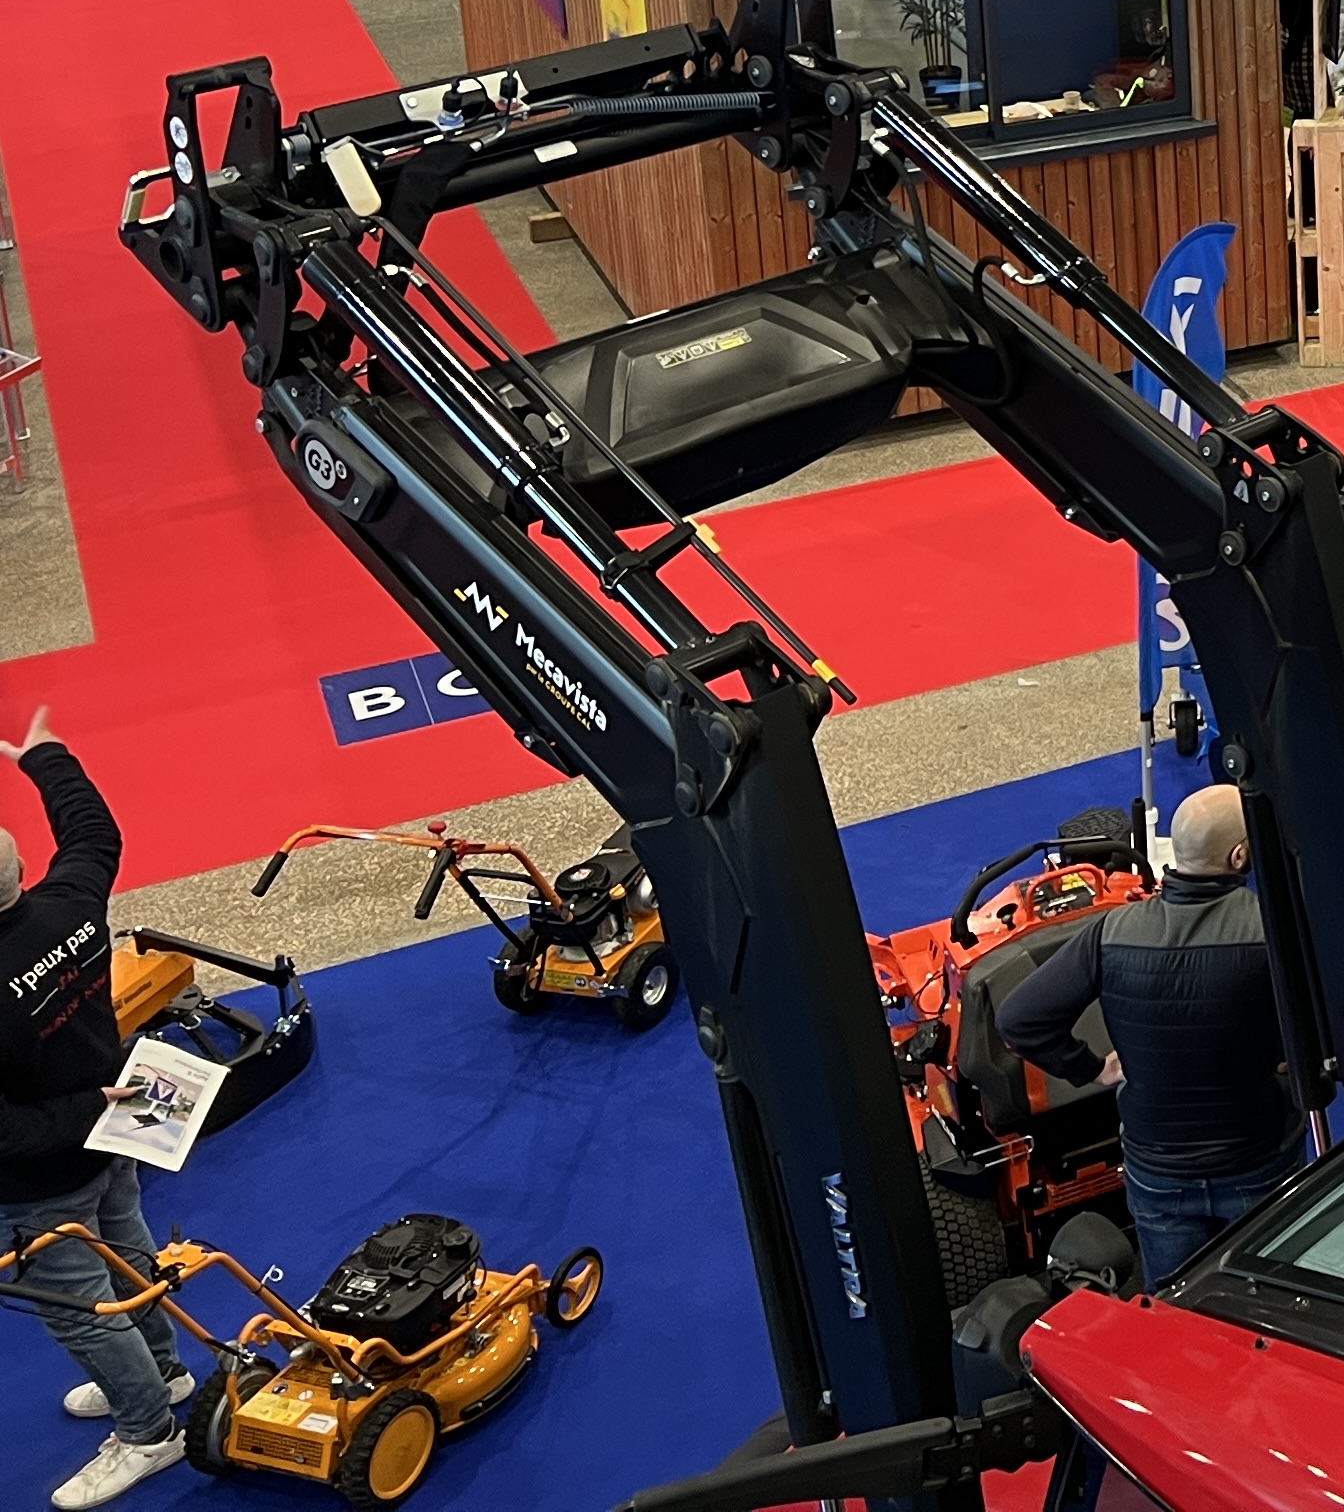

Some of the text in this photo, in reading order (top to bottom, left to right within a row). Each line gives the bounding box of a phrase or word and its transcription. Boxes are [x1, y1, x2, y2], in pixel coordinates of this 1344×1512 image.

[307, 451, 332, 478] G3
[515, 622, 606, 732] Mecavista
[347, 686, 405, 721] B
[576, 712, 591, 731] CAL
[8, 945, 67, 999] J'peux
[66, 920, 96, 956] pas
